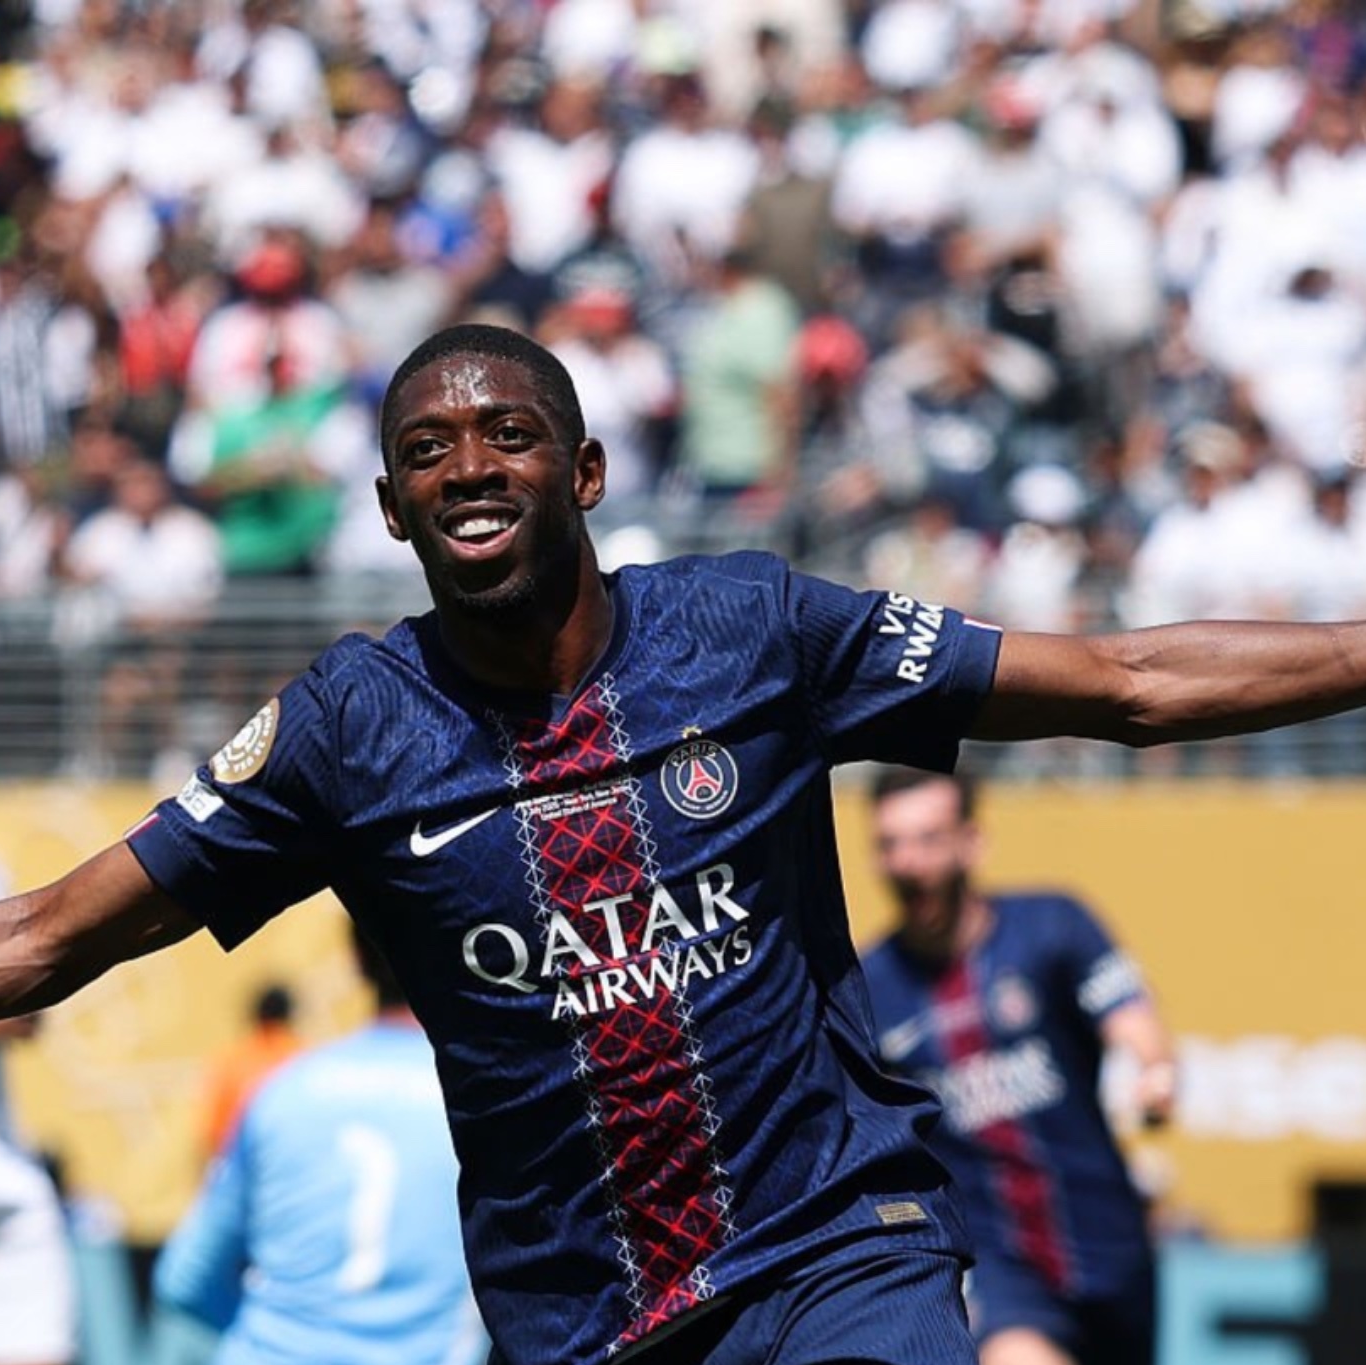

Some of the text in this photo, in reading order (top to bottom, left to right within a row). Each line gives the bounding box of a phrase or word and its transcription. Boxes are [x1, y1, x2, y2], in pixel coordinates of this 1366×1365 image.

[671, 743, 718, 767] PARIS
[462, 863, 750, 994] QATAR
[552, 925, 753, 1021] AIRWAYS
[339, 1120, 400, 1291] 1
